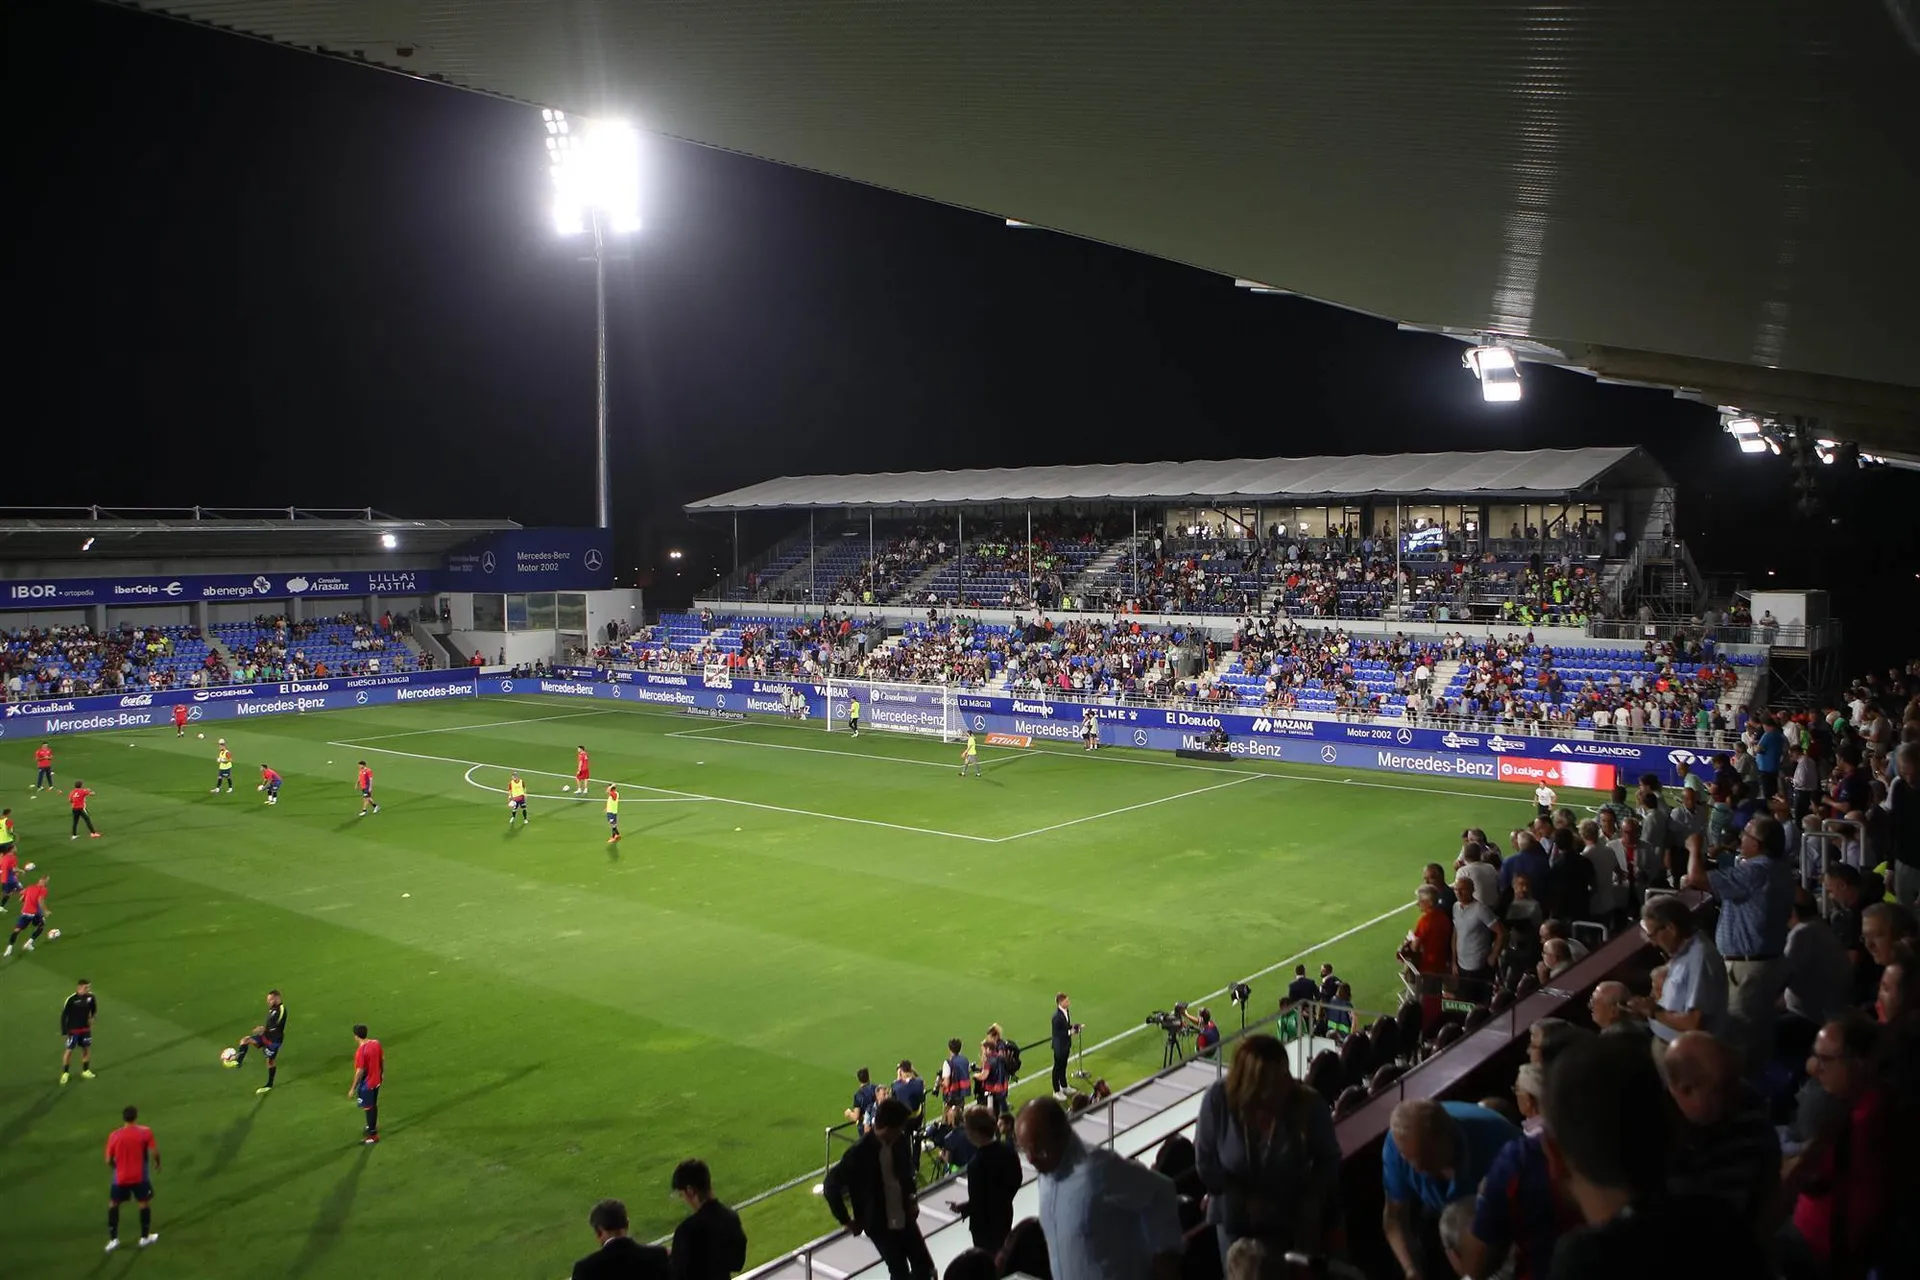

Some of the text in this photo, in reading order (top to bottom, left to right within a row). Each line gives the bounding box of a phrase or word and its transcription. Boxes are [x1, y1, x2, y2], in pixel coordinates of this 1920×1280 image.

[517, 551, 570, 560] Mercedes-Benz
[517, 563, 559, 572] Motor 2002
[369, 573, 416, 582] LILLAS
[12, 585, 94, 598] IBOR ortopedia
[310, 582, 349, 591] Arasanz
[369, 582, 416, 591] PASTIA
[210, 688, 254, 698] COSEHISA
[397, 684, 472, 700] Mercedes-Benz
[541, 681, 594, 695] Mercedes-Benz
[639, 688, 695, 704] Mercedes-Benz
[22, 702, 75, 714] CaixaBank
[237, 698, 325, 715] Mercedes-Benz
[1012, 700, 1054, 715] Alcampo
[46, 713, 151, 732] Mercedes-Benz
[872, 708, 945, 726] Mercedes-Benz
[1274, 719, 1314, 731] MAZANA
[1347, 728, 1392, 739] Motor 2002
[989, 736, 1021, 745] STIHL
[1574, 745, 1641, 757] ALEJANDRO
[1378, 751, 1494, 776] Mercedes-Benz
[1513, 767, 1544, 778] LaLiga
